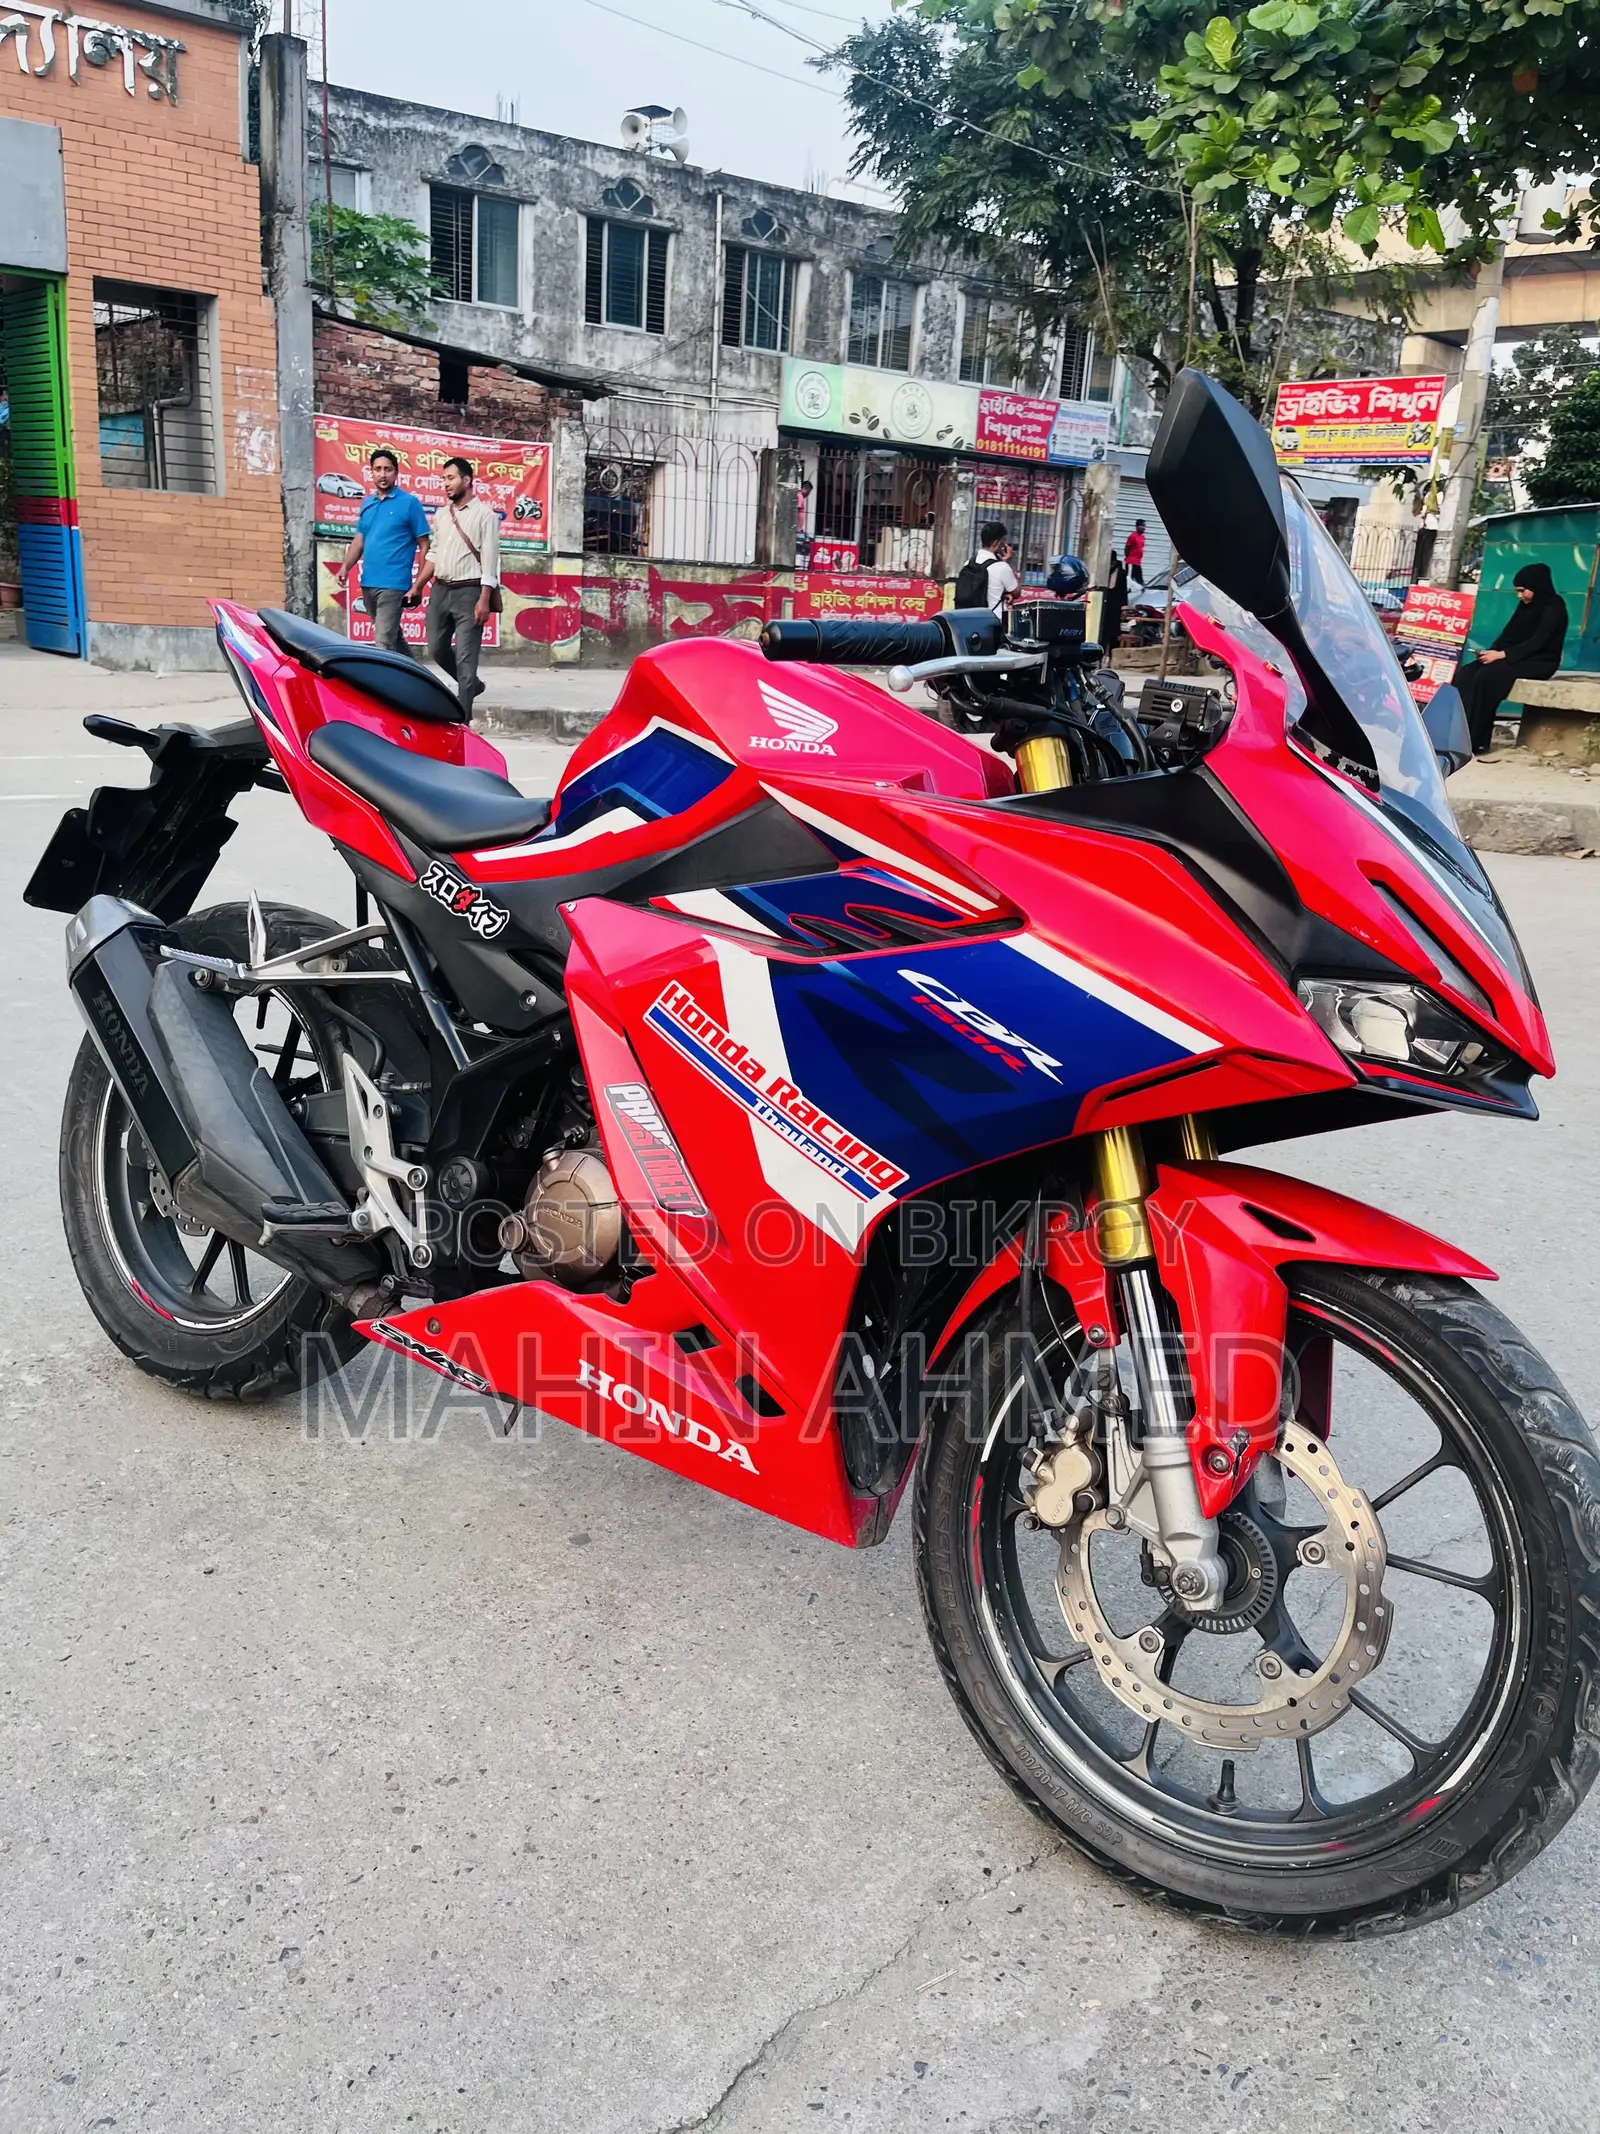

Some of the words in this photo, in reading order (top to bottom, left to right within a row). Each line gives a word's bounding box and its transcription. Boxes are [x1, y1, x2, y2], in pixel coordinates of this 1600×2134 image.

[1276, 387, 1361, 422] ড্রাইভিং
[1367, 386, 1441, 419] শিখুন
[486, 461, 527, 483] কেন্দ্র
[976, 437, 1047, 459] 01811114191
[1425, 608, 1469, 633] শিখুন
[748, 735, 838, 757] HONDA
[91, 988, 150, 1099] HONDA
[896, 969, 1064, 1086] CBR
[910, 995, 1028, 1076] 150R
[659, 982, 768, 1085] Honda
[764, 1076, 907, 1192] Racing
[751, 1096, 851, 1180] Thailand
[542, 1204, 584, 1229] HONDA
[575, 1358, 761, 1476] HONDA
[1016, 1745, 1069, 1800] 100/80-17
[1065, 1797, 1093, 1825] M/C
